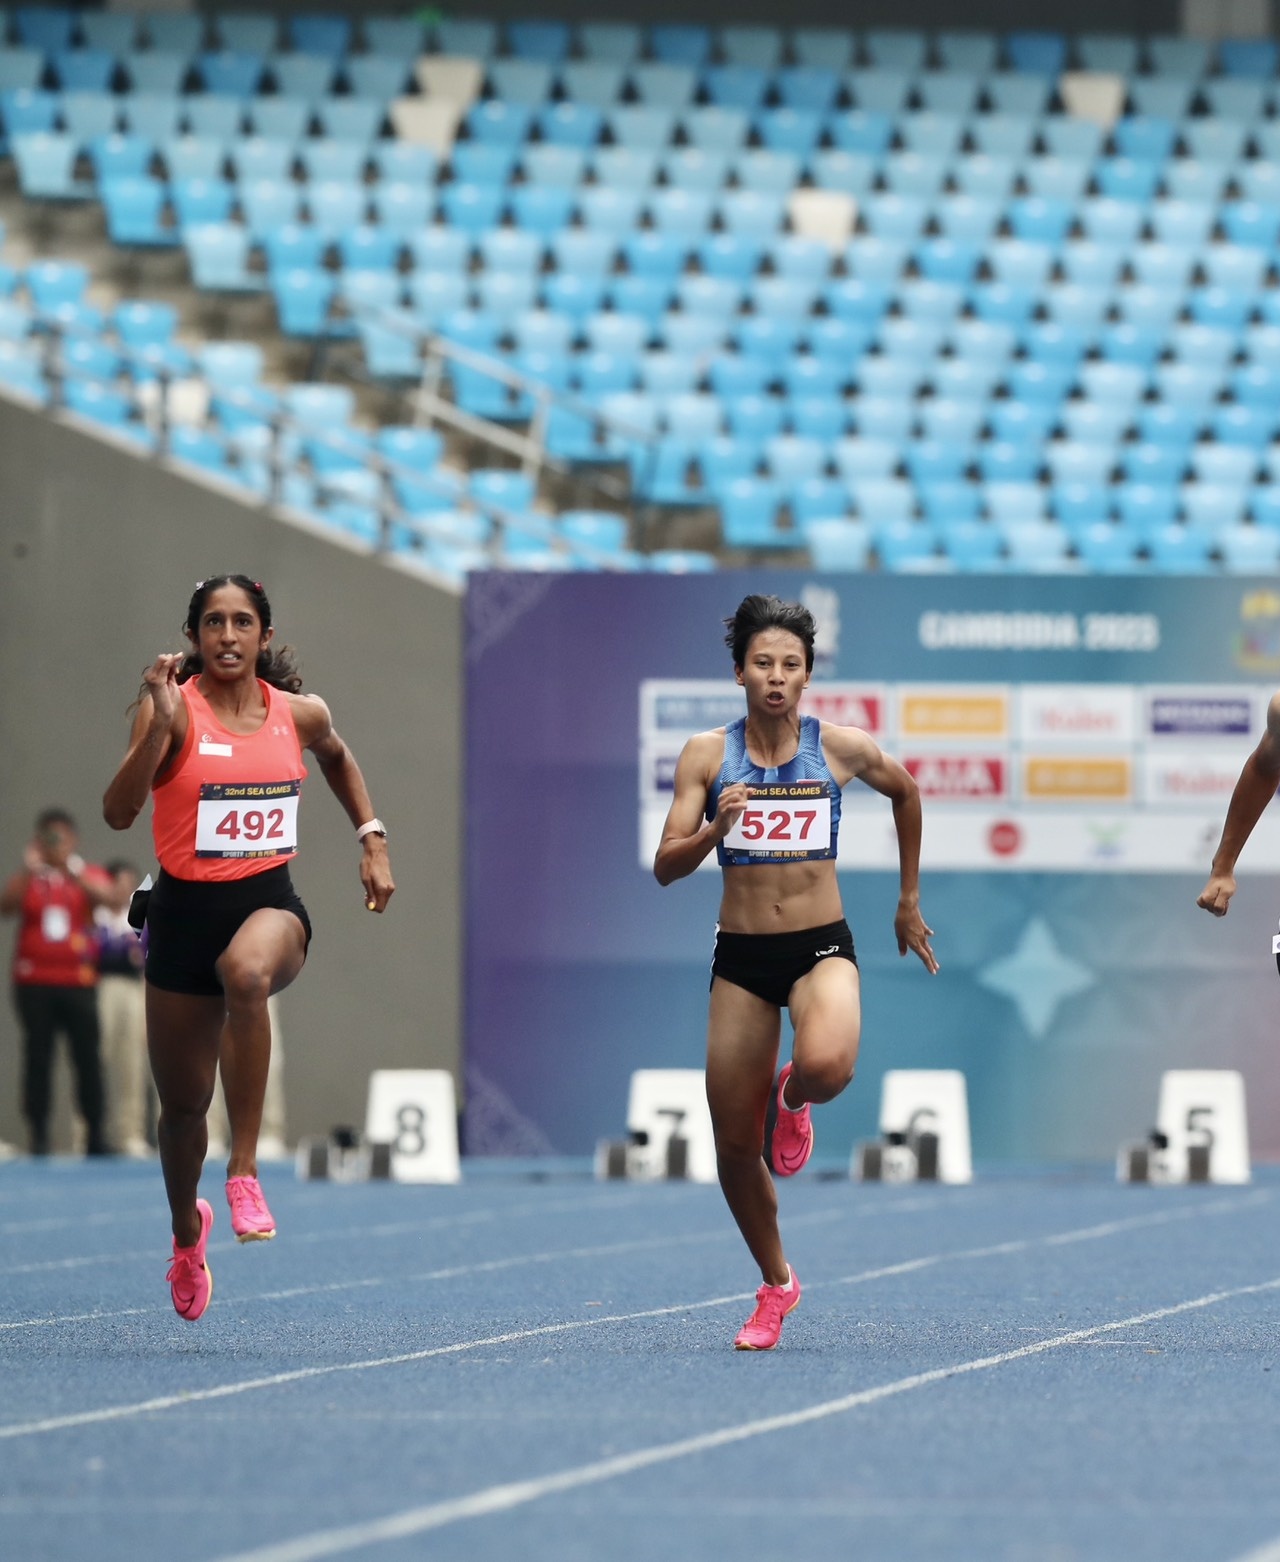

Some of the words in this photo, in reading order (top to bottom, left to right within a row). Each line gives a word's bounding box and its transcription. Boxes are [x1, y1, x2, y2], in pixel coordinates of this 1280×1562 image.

[224, 787, 245, 796] 32nd
[246, 787, 265, 795] SEA
[266, 785, 292, 795] GAMES
[769, 788, 788, 796] SEA
[789, 787, 821, 795] GAMES
[215, 808, 284, 840] 492
[741, 810, 817, 840] 527
[397, 1103, 425, 1157] 8
[656, 1108, 687, 1142] 7
[1186, 1107, 1214, 1148] 5
